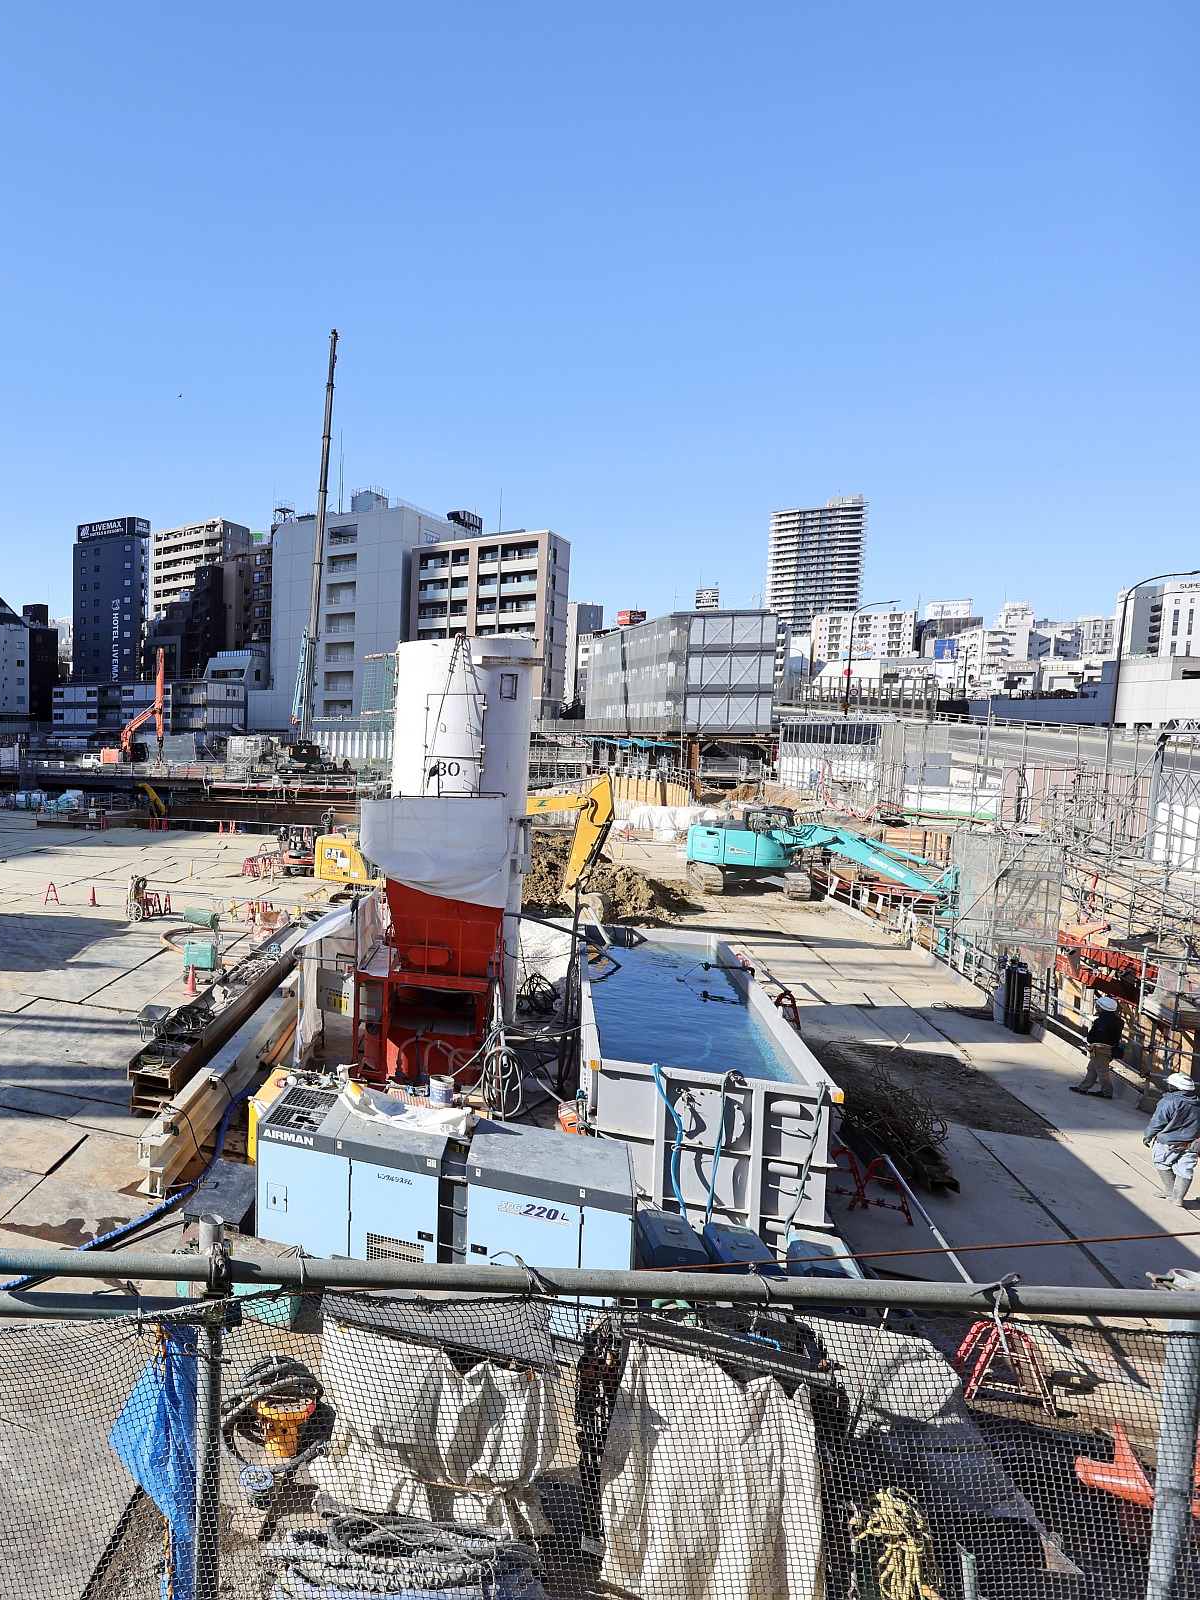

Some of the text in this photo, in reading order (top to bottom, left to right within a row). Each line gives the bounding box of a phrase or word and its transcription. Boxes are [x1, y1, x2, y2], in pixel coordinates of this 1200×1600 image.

[325, 848, 343, 860] CAT
[262, 1128, 314, 1147] AIRMAN
[377, 1173, 413, 1186] レンタルシステム
[522, 1203, 559, 1221] 220
